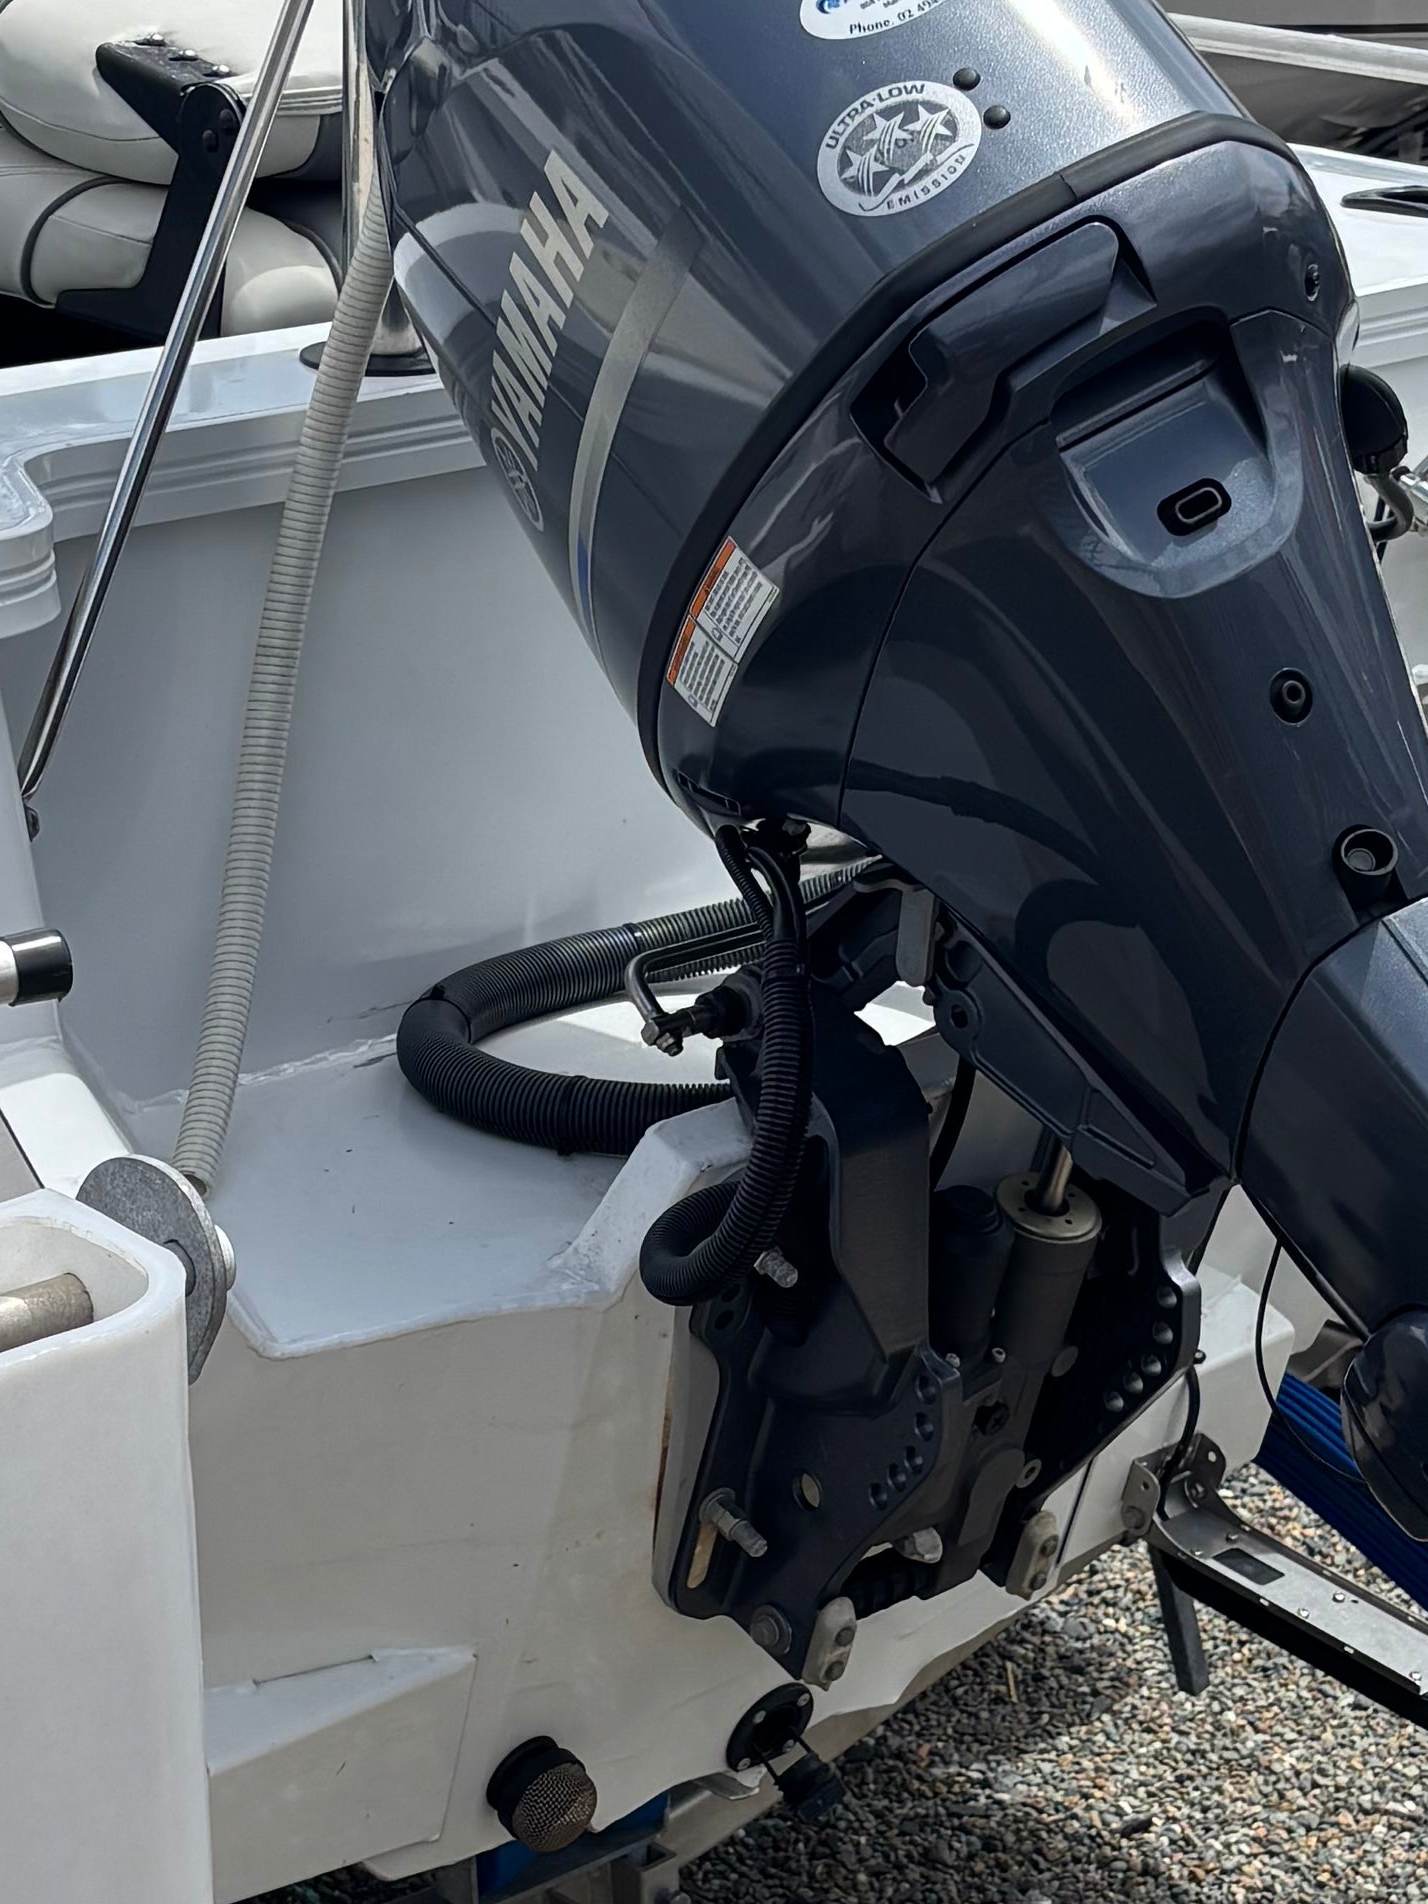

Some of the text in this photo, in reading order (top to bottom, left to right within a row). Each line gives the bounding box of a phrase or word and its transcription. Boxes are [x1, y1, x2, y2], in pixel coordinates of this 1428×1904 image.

[897, 10, 914, 22] 02
[887, 154, 967, 210] EMISSION
[491, 149, 610, 472] YAMAHA
